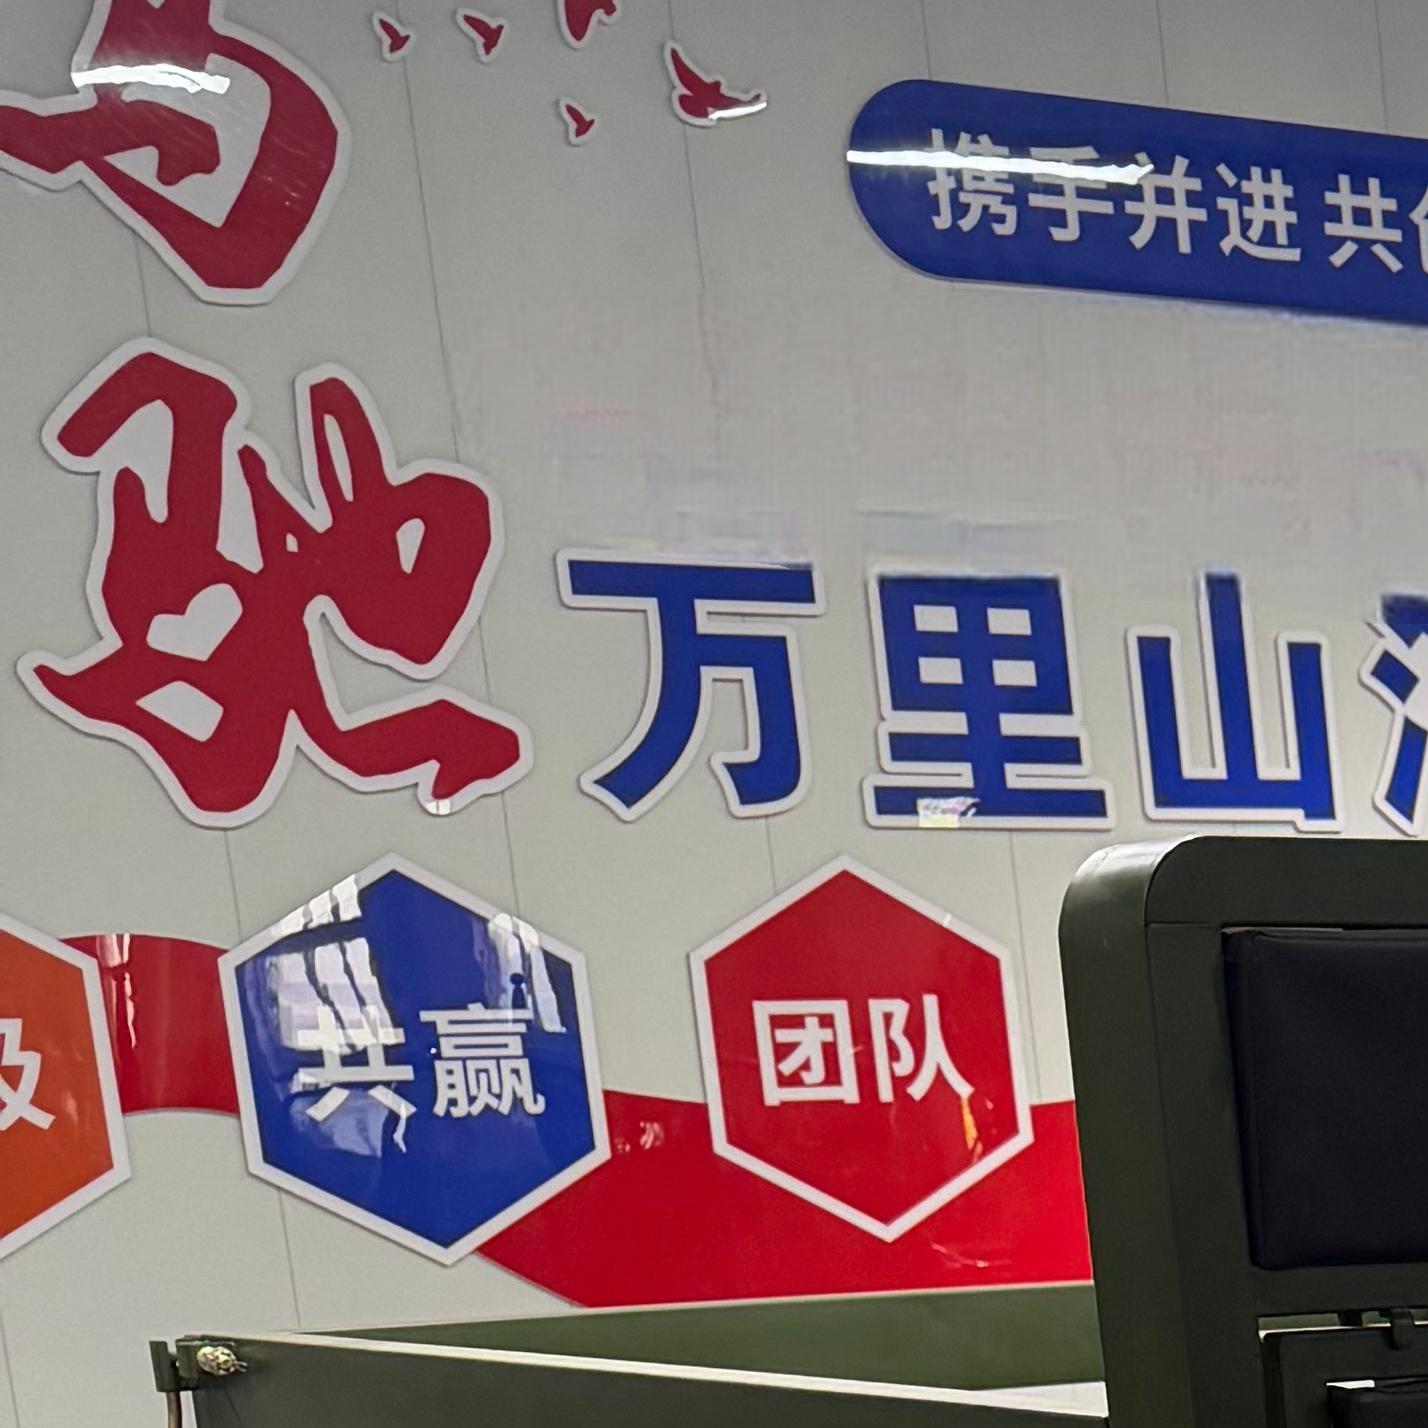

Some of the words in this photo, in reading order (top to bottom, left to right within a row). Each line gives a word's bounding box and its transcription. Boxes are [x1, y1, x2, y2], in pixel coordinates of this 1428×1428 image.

[926, 127, 1301, 263] 携手并进
[296, 1002, 546, 1122] 共赢
[751, 993, 976, 1107] 团队
